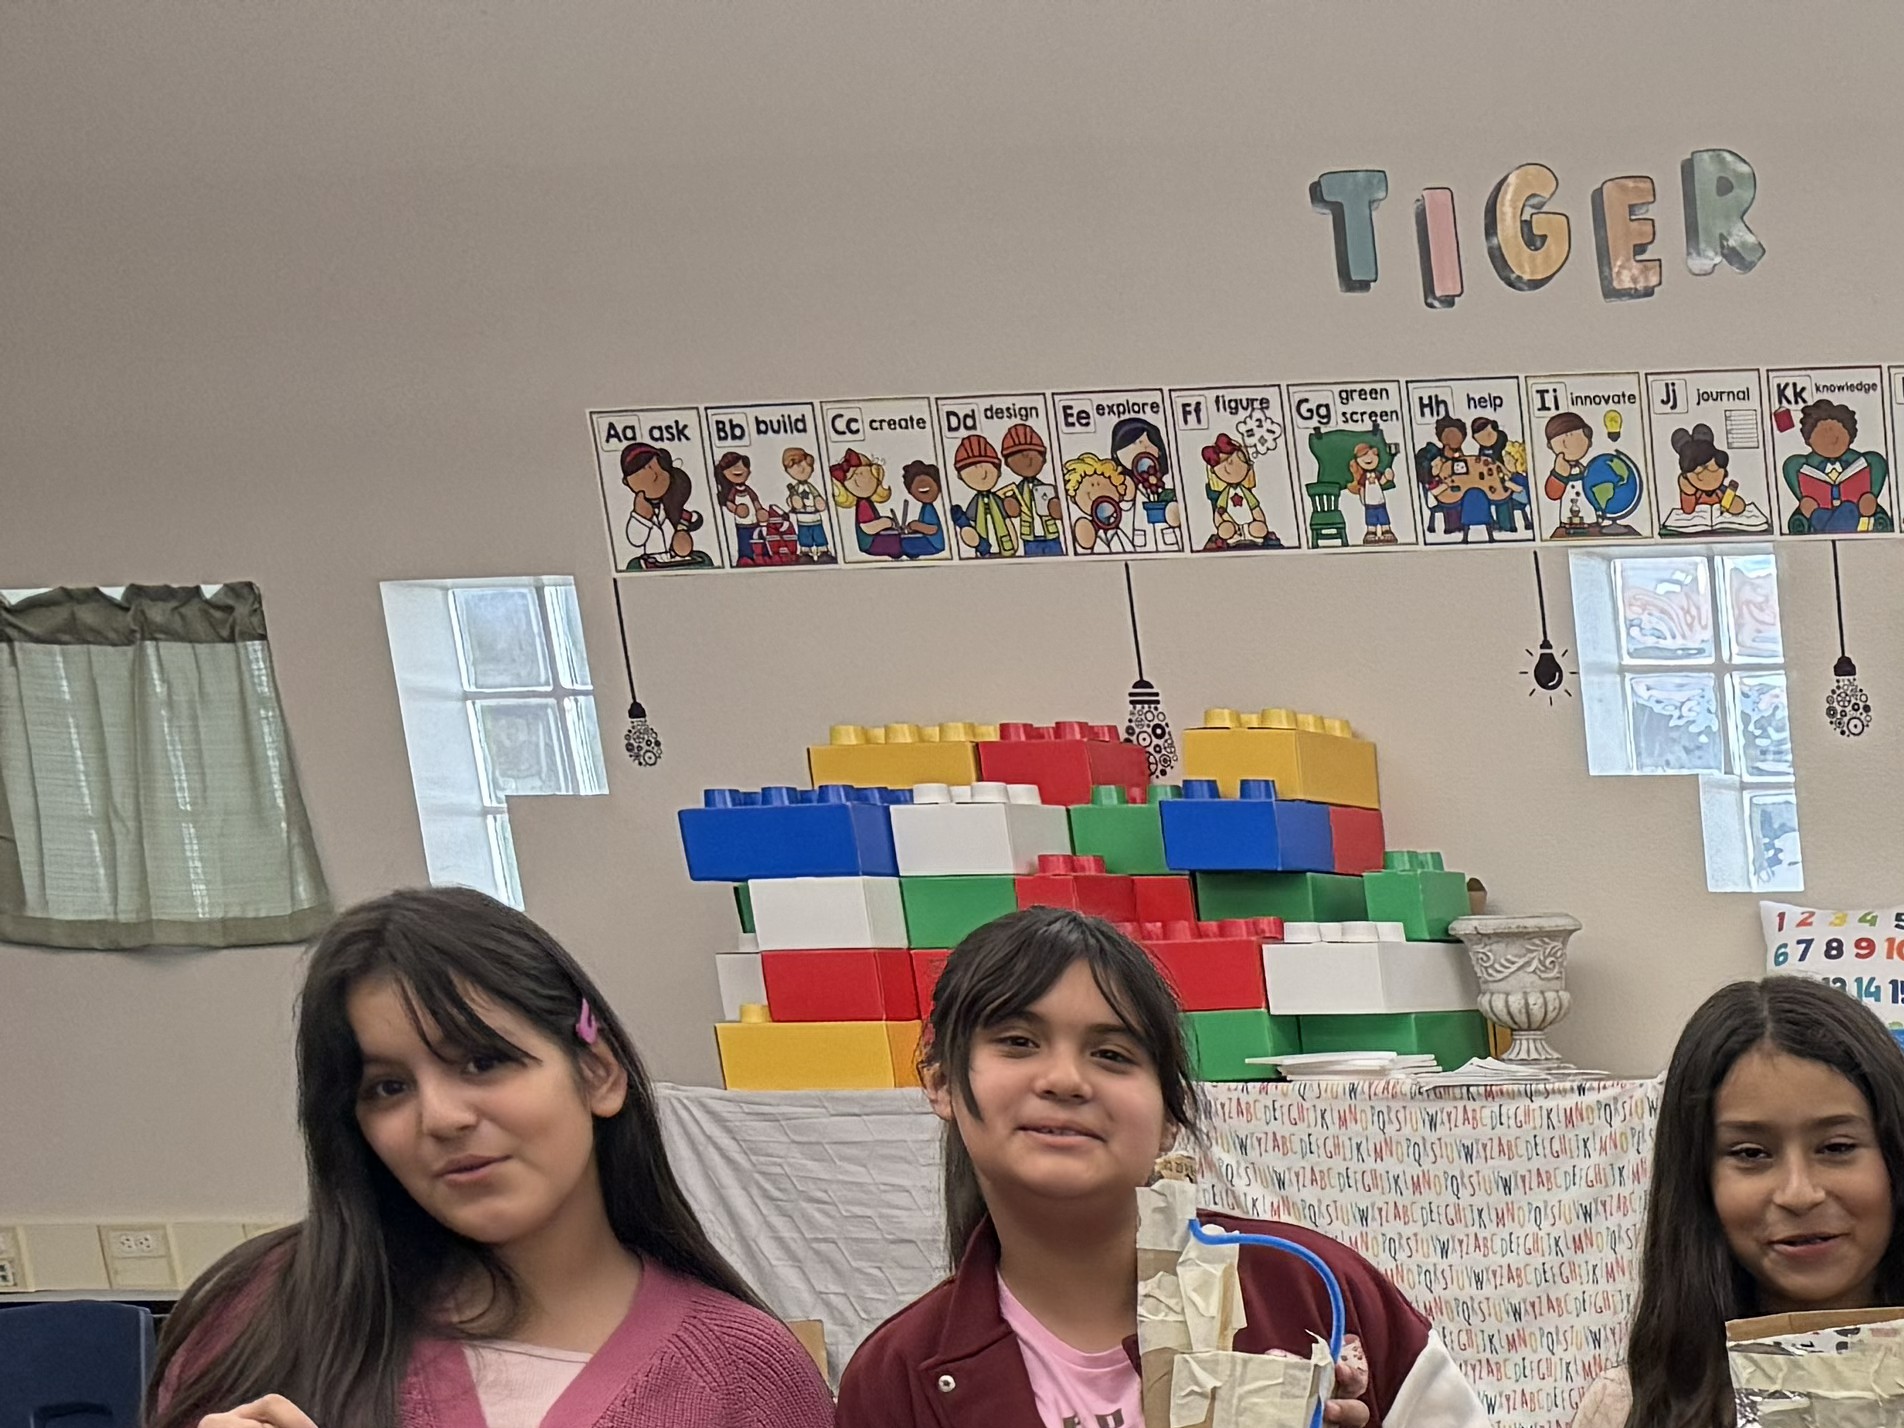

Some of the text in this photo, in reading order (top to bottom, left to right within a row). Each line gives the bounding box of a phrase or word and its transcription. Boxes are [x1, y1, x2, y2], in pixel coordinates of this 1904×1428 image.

[1309, 148, 1765, 308] TIGER
[1295, 385, 1388, 425] Gg green
[1418, 392, 1503, 418] Hh help
[1535, 389, 1635, 411] Ii innovate
[1660, 383, 1750, 405] Jj journal
[1776, 380, 1877, 405] Kk knowledge
[946, 403, 1039, 432] Dd design
[1062, 400, 1160, 427] Ee explore
[1183, 394, 1270, 425] Ff figure
[1341, 406, 1398, 424] screen
[605, 420, 692, 443] Aa ask
[715, 413, 808, 441] Bb build
[831, 414, 928, 437] Cc create
[1775, 911, 1786, 932] 1
[1795, 911, 1815, 928] 2
[1828, 912, 1846, 928] 3
[1857, 911, 1878, 928] 4
[1773, 943, 1788, 967] 6
[1795, 937, 1815, 962] 7
[1824, 937, 1844, 960] 8
[1854, 937, 1875, 960] 9
[1854, 977, 1881, 1006] 14
